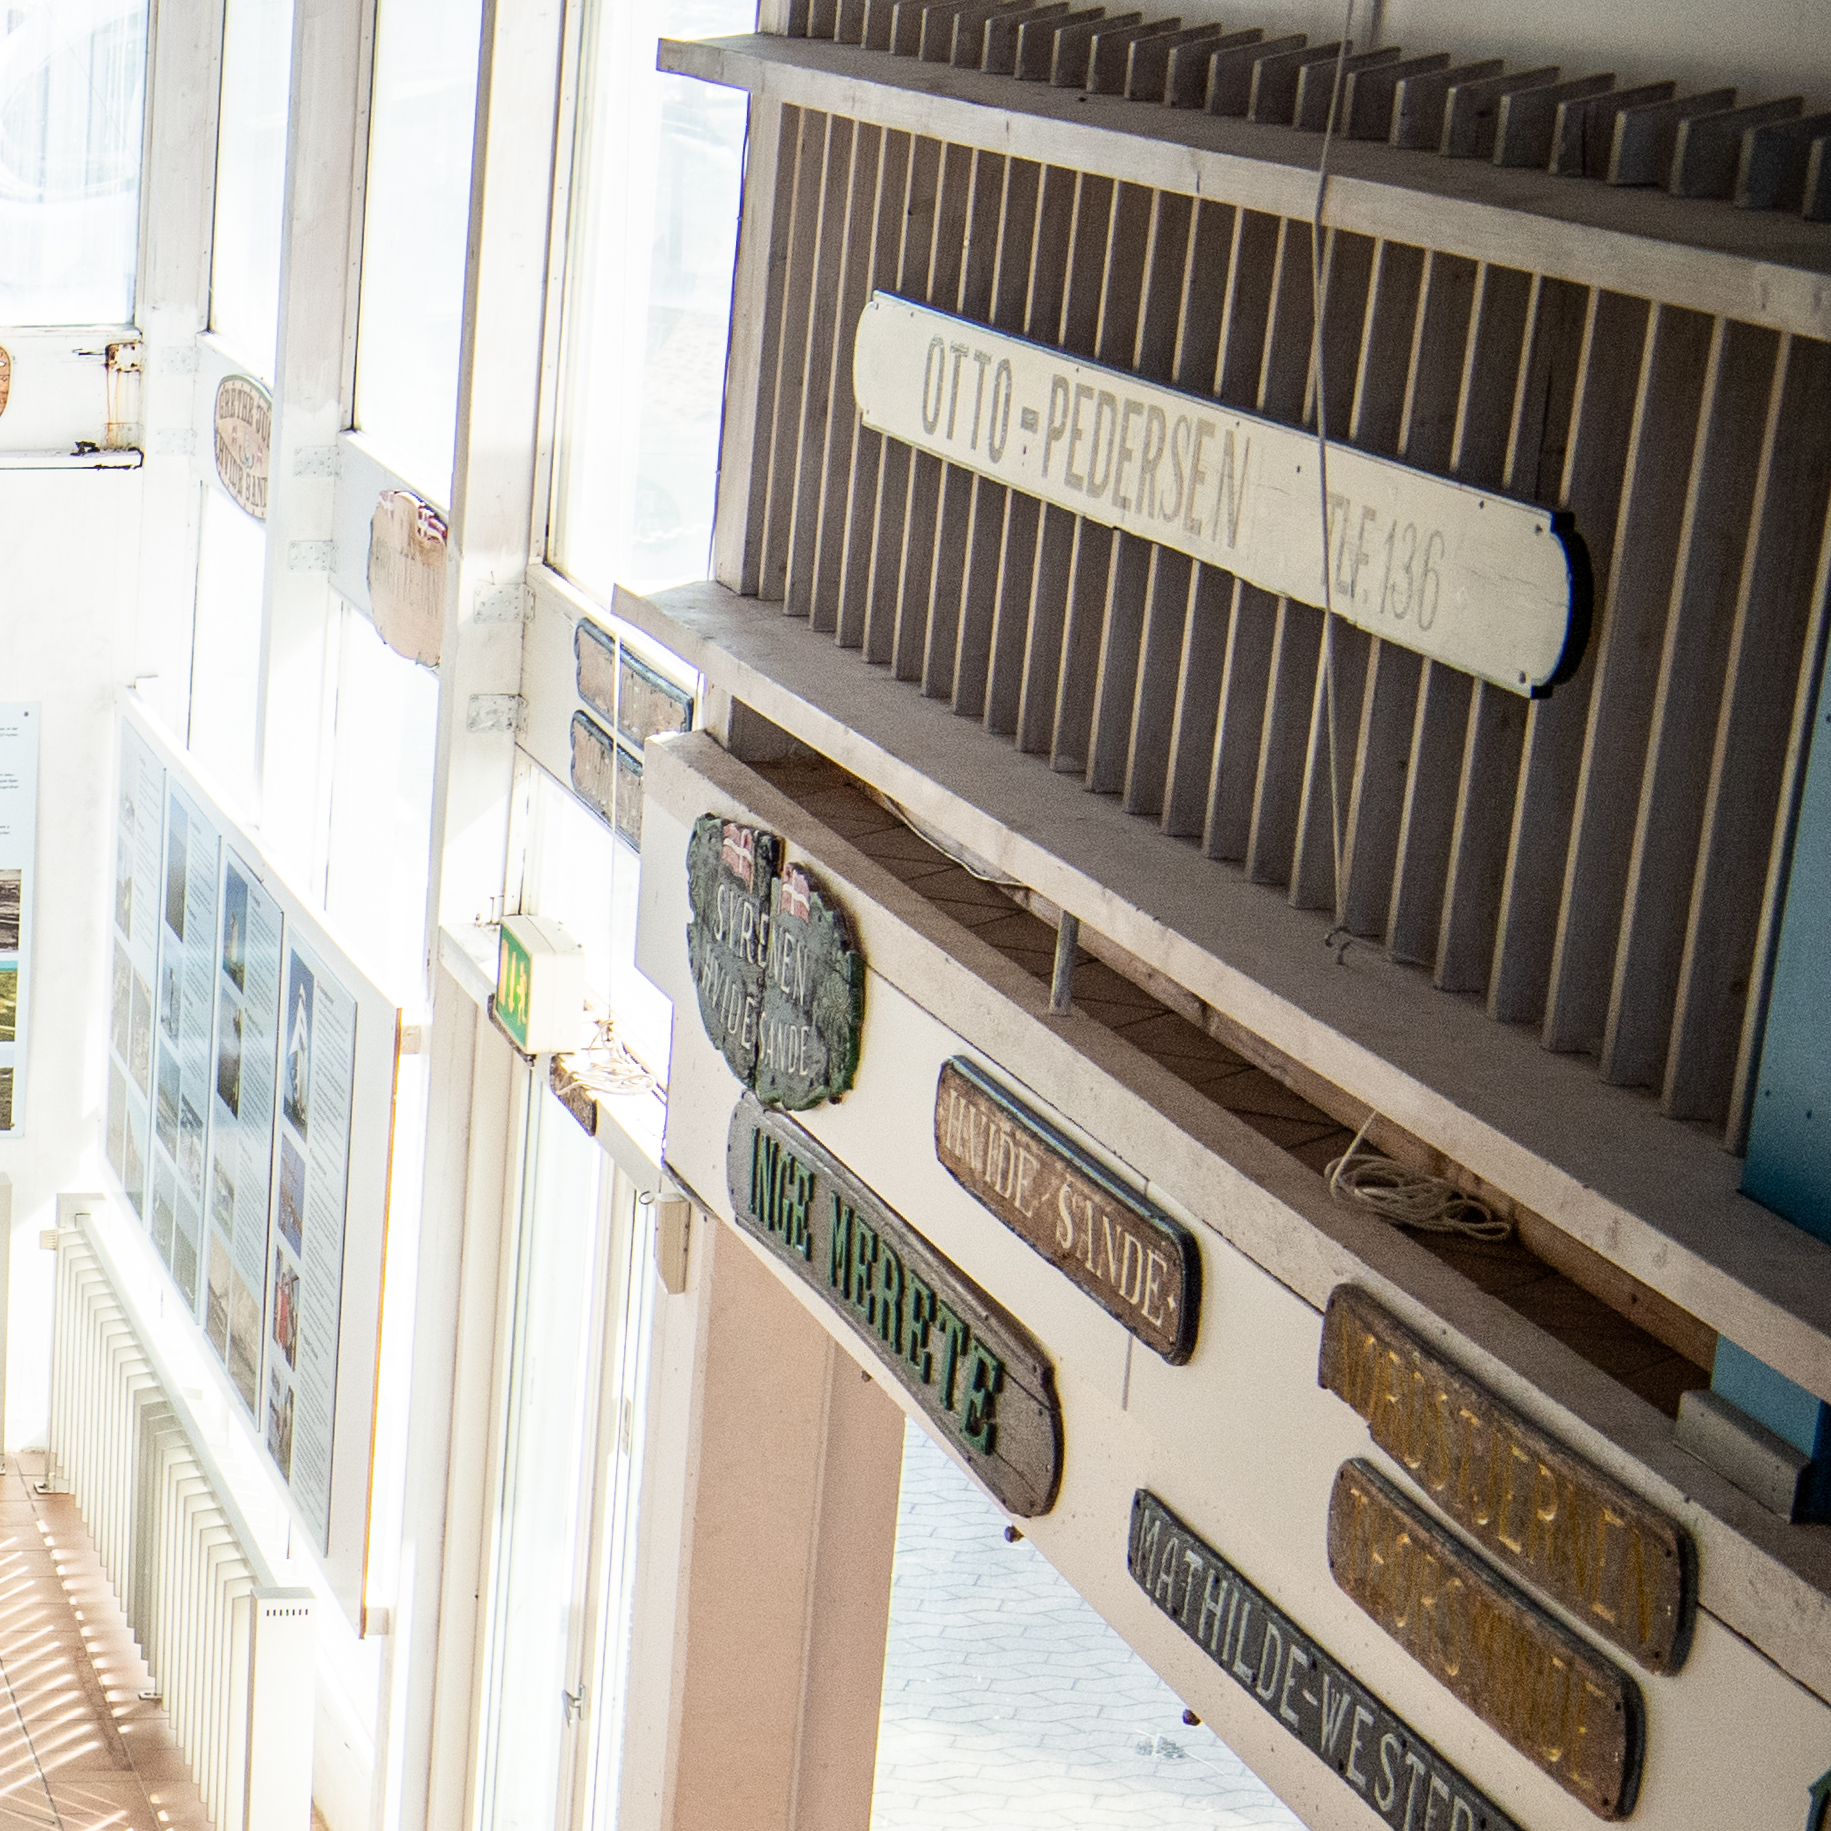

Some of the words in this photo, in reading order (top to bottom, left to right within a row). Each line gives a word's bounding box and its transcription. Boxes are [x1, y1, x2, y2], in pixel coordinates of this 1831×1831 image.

[1379, 518, 1446, 633] 136
[713, 883, 809, 1007] SYRENEN
[758, 1010, 810, 1077] SANDE
[944, 1086, 1039, 1222] HVIDE
[1054, 1180, 1171, 1328] SANDE
[748, 1125, 816, 1262] INGE
[830, 1188, 1005, 1456] MERETE
